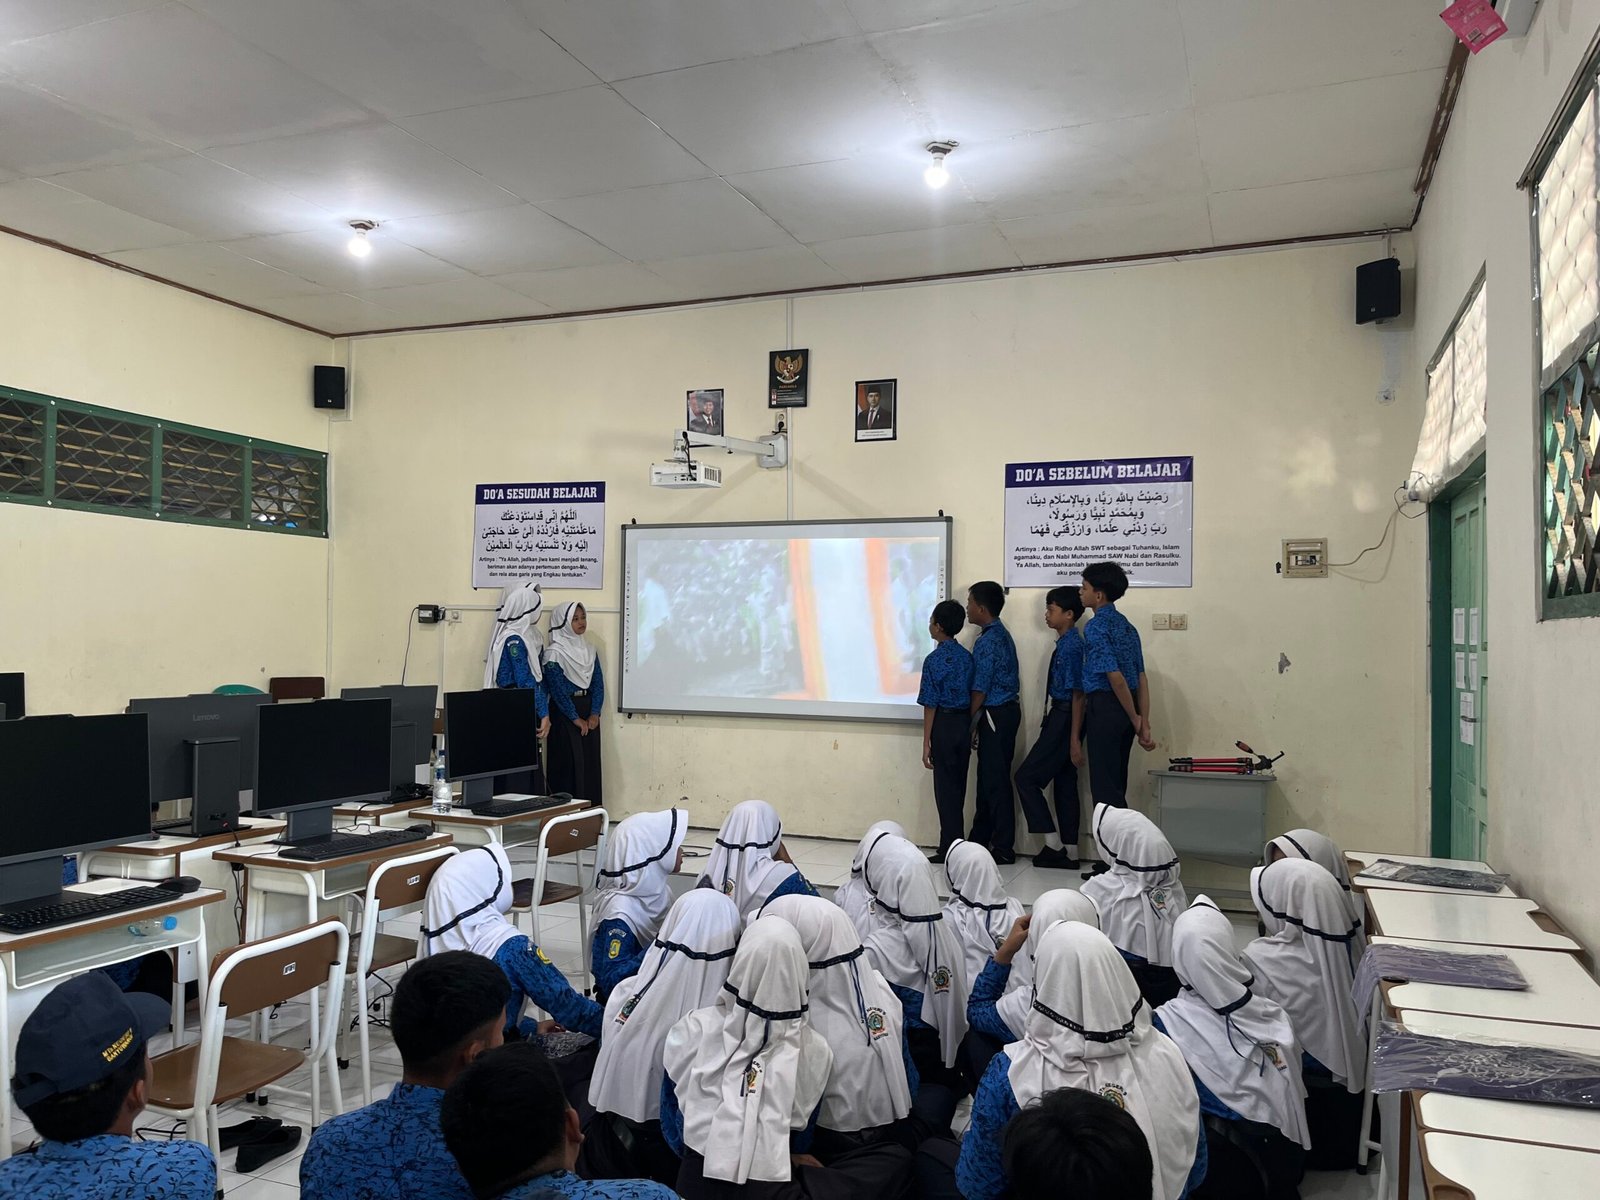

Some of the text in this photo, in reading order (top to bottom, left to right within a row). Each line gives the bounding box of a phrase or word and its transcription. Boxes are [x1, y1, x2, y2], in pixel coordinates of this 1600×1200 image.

[1015, 463, 1181, 482] DO'A SEBELUM BELAJAR
[483, 487, 597, 500] DO'A SESUDAH BELAJAR
